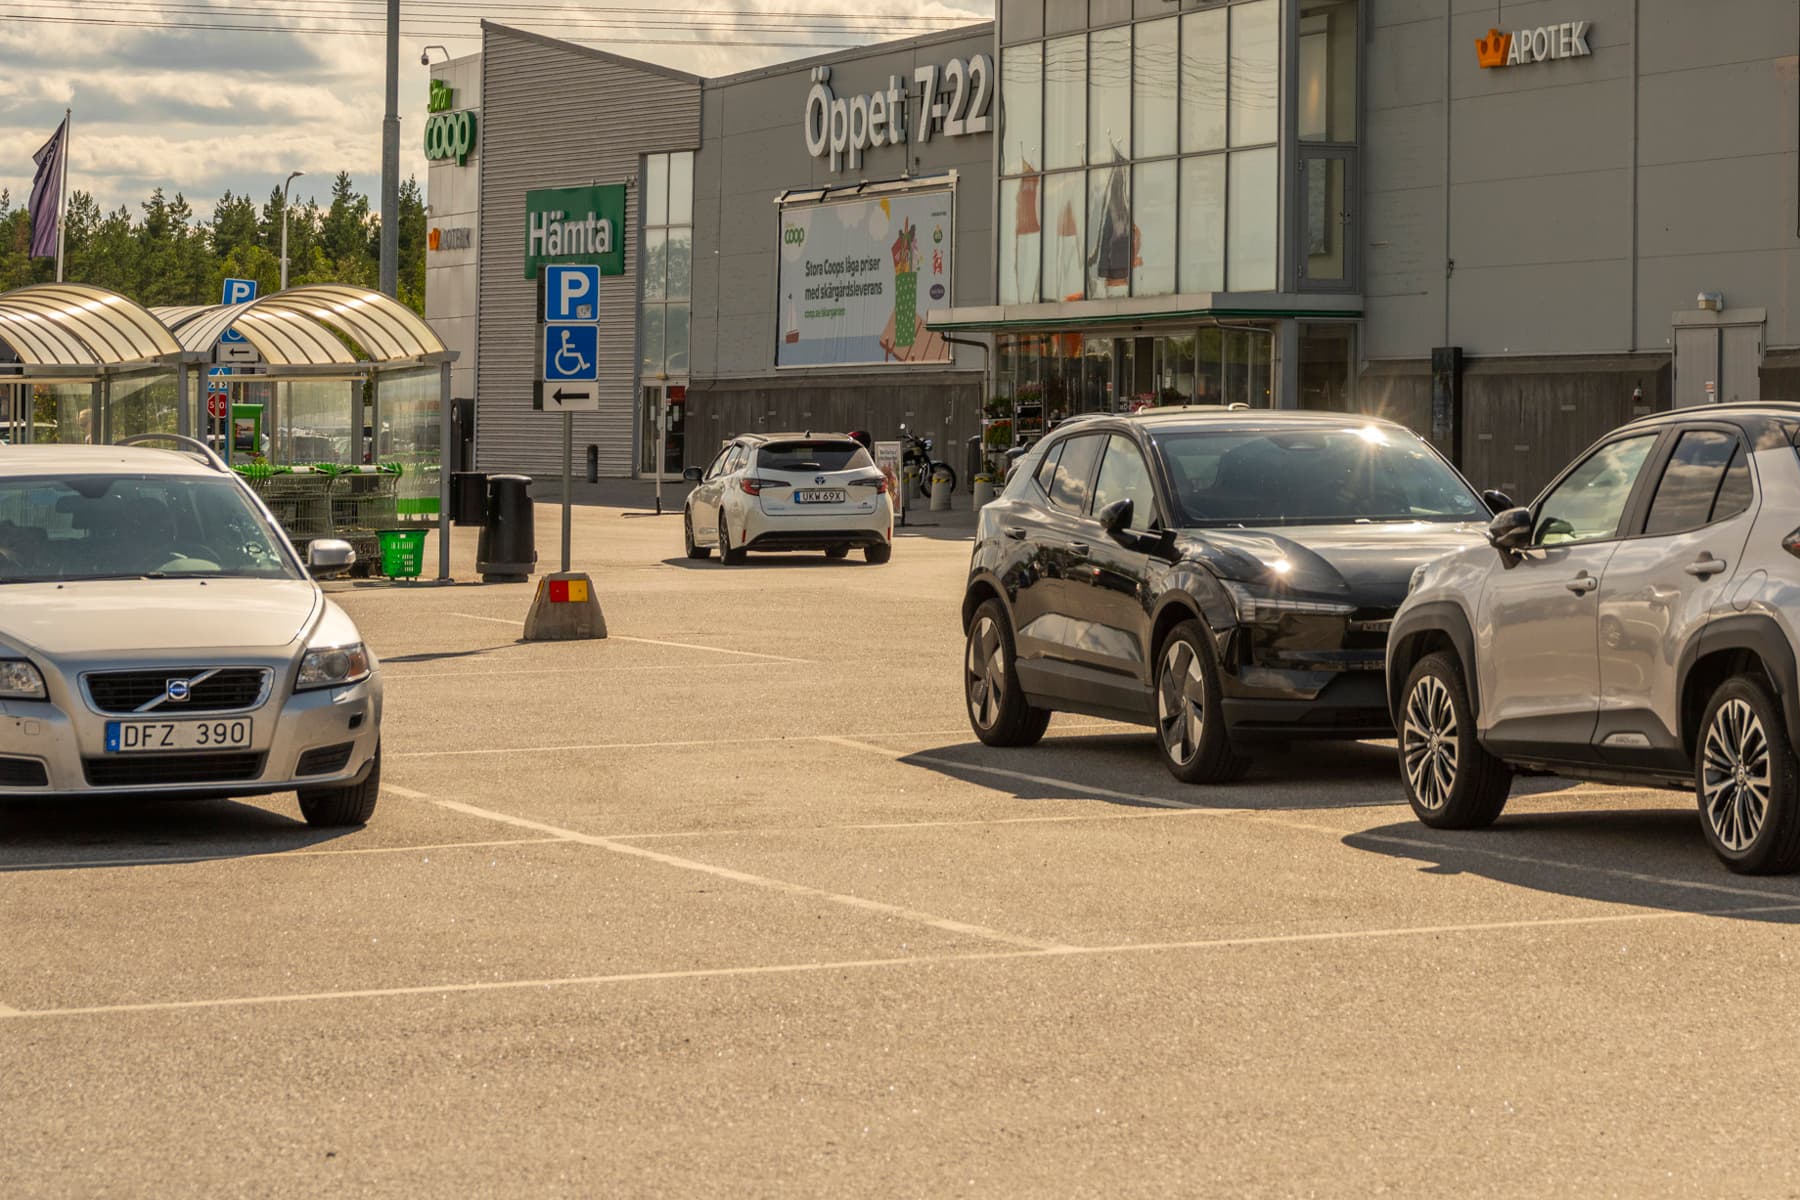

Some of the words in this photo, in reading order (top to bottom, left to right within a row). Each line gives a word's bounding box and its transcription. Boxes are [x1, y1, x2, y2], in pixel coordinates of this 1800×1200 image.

[1506, 21, 1591, 66] APOTEK
[805, 65, 908, 172] Öppet
[914, 54, 994, 142] 7-22
[424, 111, 477, 167] coop
[529, 210, 613, 257] Hämta
[784, 227, 805, 247] coop
[805, 260, 823, 277] Stora
[824, 259, 844, 278] Coops
[845, 255, 859, 277] låga
[860, 256, 881, 276] priser
[231, 282, 250, 305] P
[560, 271, 590, 315] P
[804, 283, 820, 301] med
[802, 491, 820, 501] UKW
[823, 490, 841, 501] 69X
[124, 724, 175, 748] DFZ
[196, 722, 245, 744] 390
